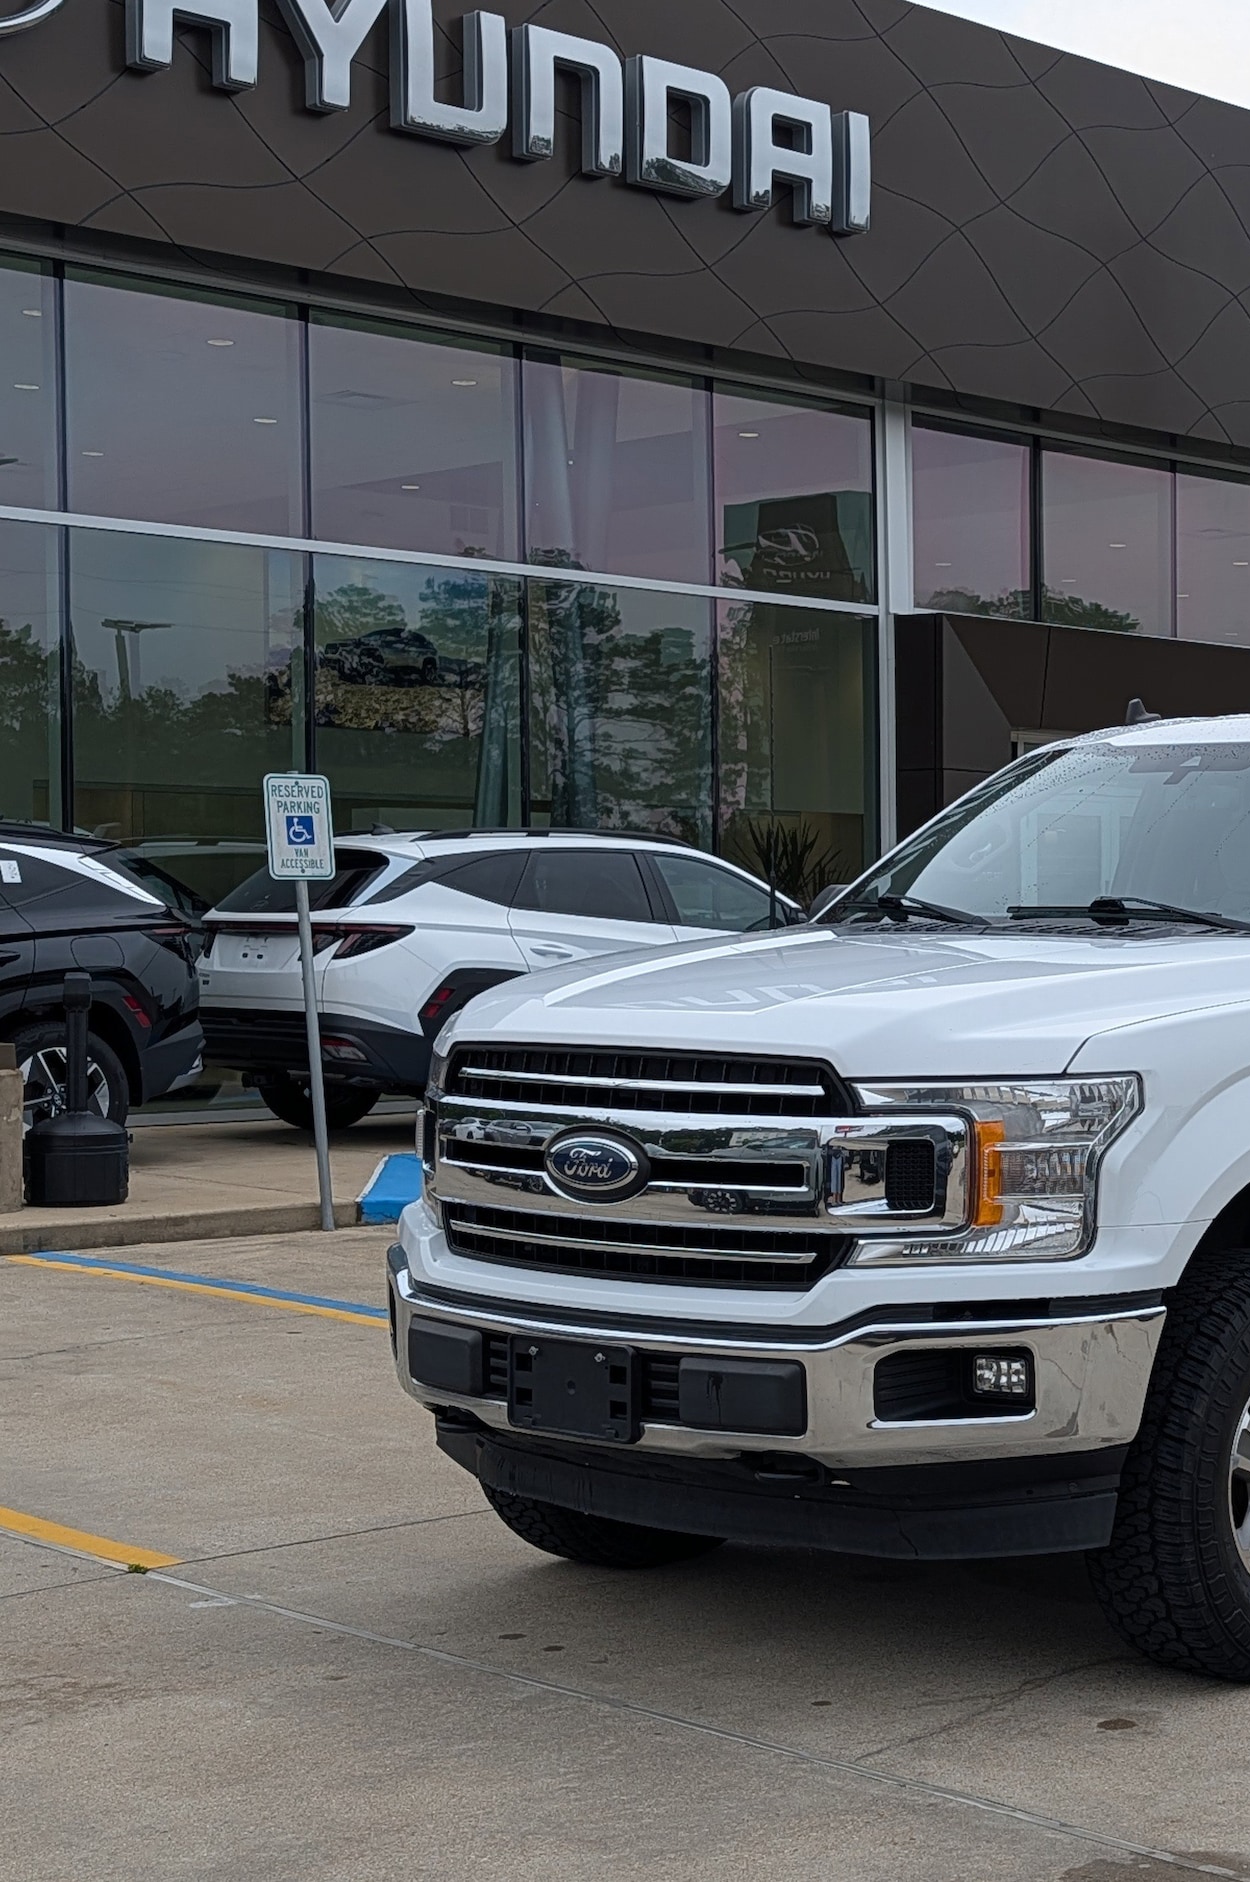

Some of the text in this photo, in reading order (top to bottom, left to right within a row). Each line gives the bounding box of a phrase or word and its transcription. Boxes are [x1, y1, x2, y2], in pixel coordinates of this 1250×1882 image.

[271, 784, 324, 799] RESERVED
[277, 800, 320, 815] PARKING
[294, 848, 309, 858] VAN
[280, 859, 325, 870] ACCESSIBLE
[563, 1147, 614, 1179] Ford
